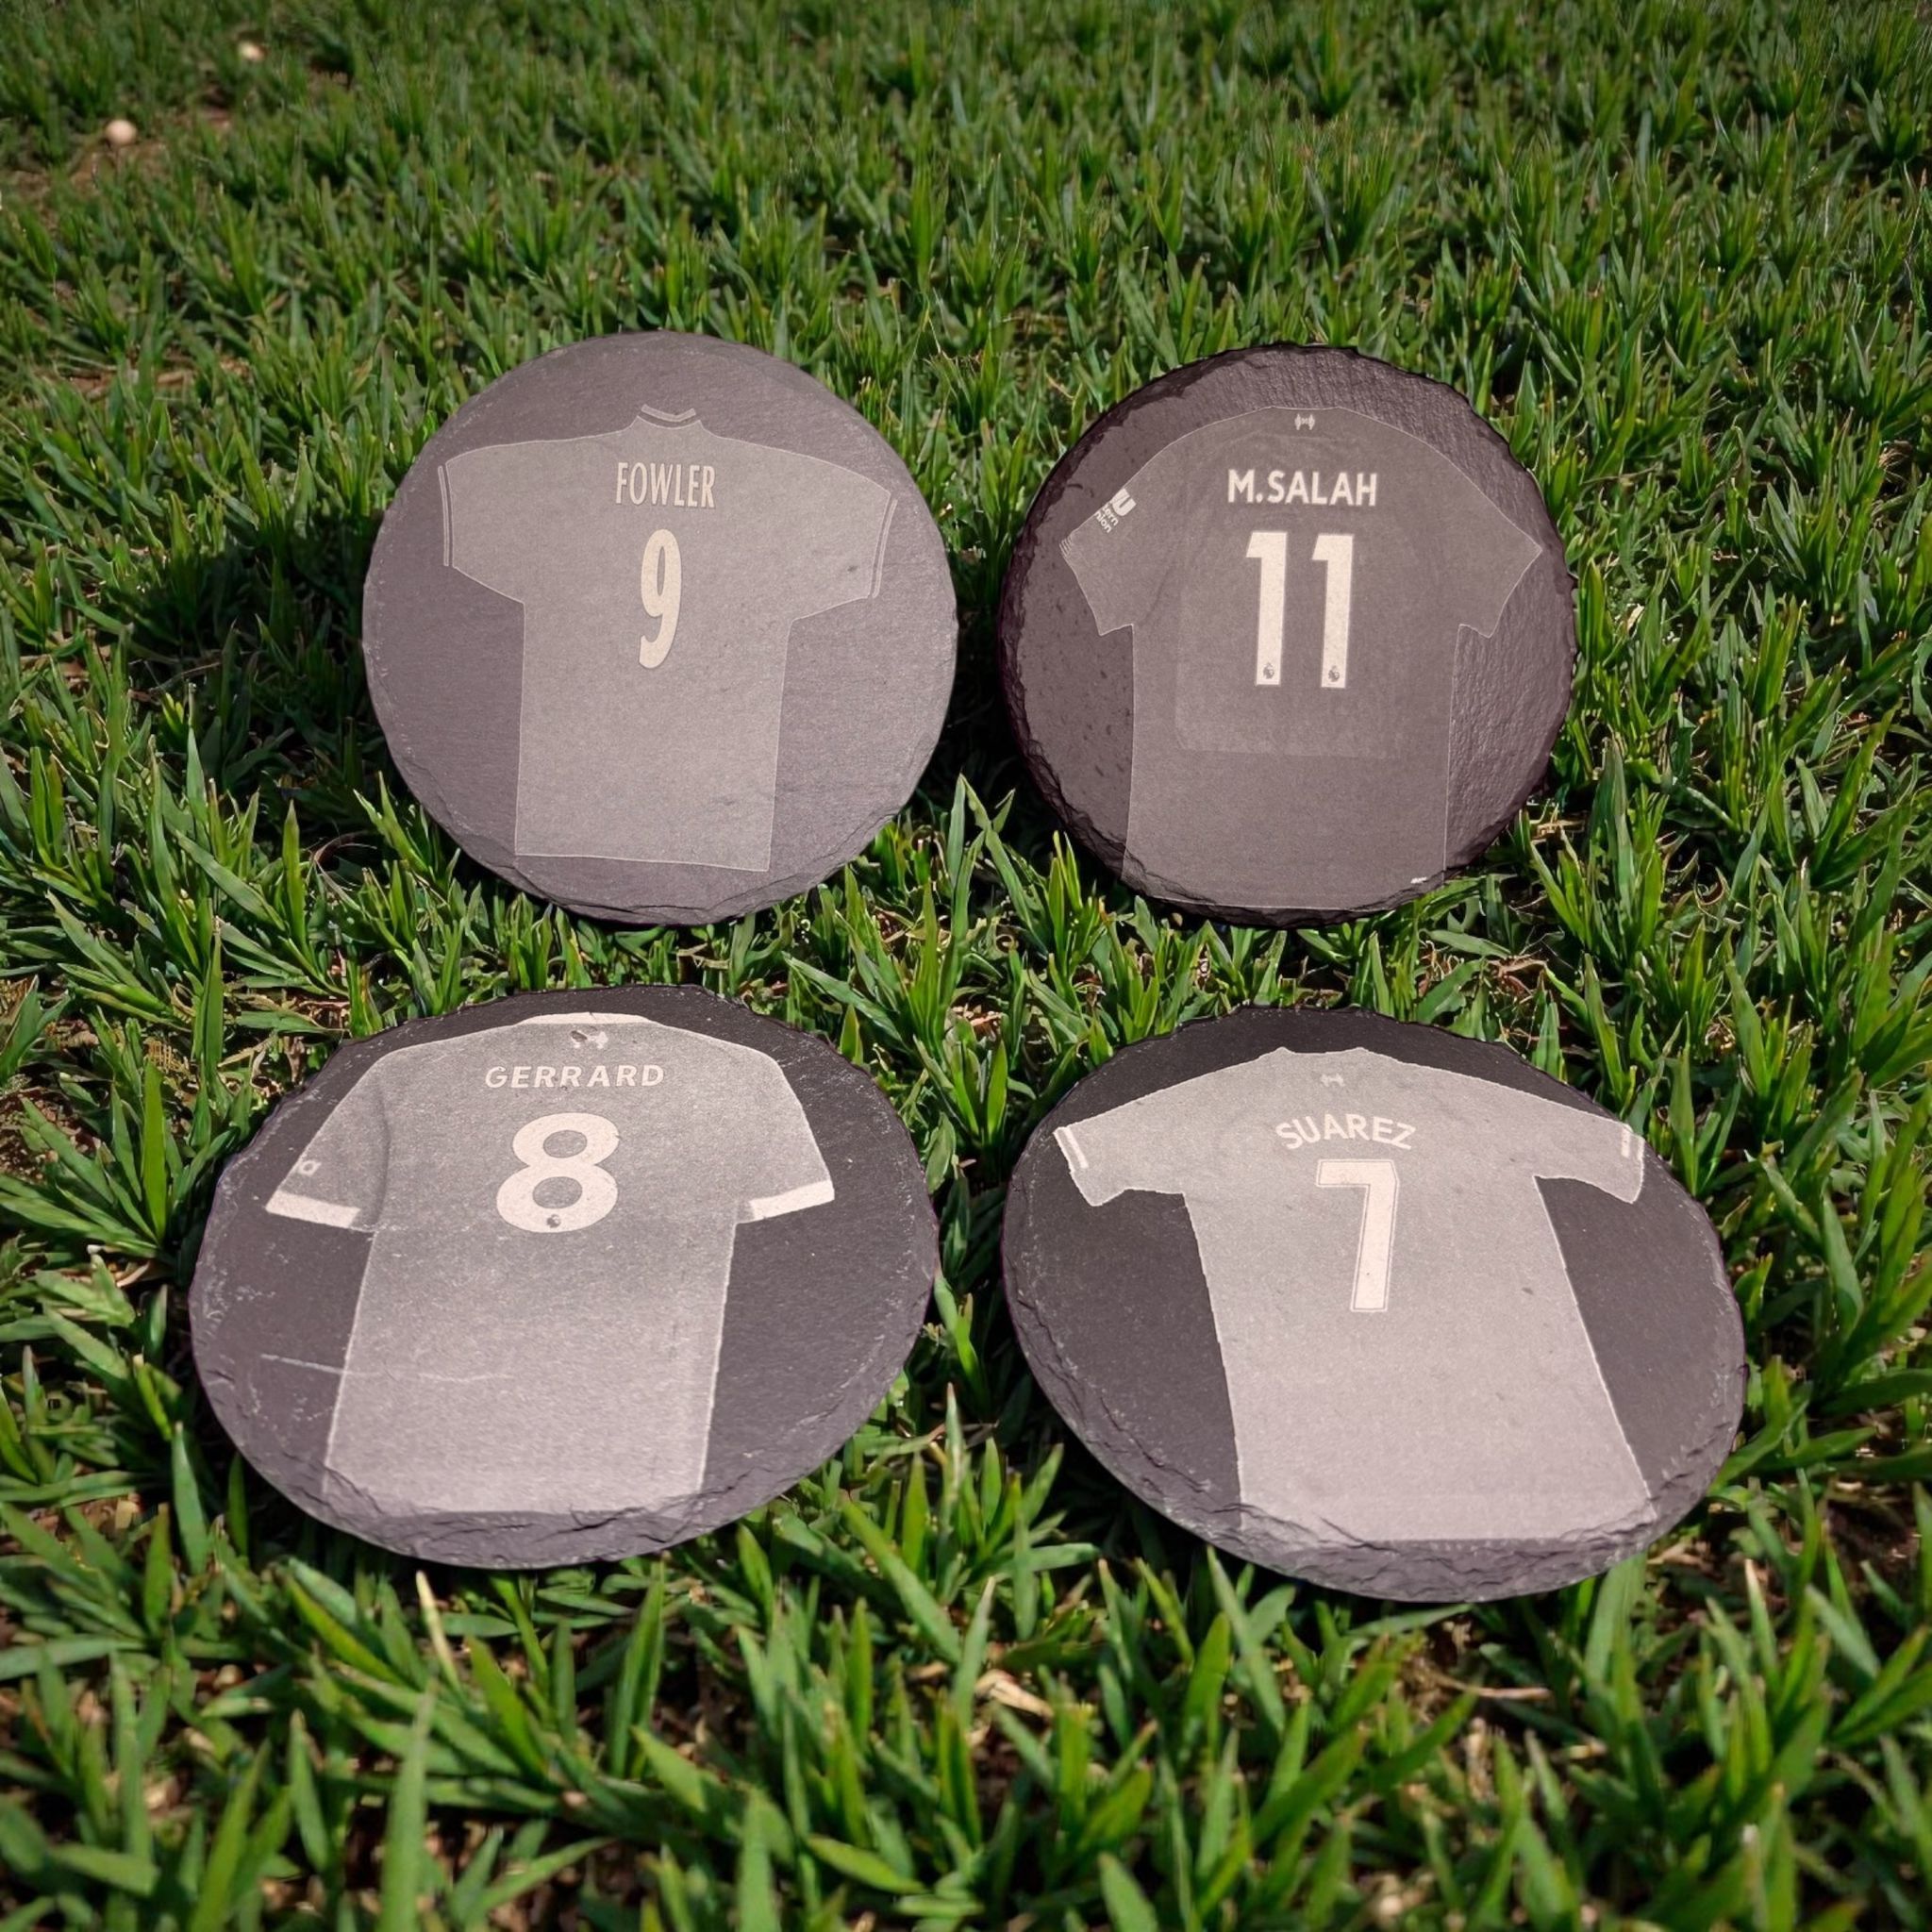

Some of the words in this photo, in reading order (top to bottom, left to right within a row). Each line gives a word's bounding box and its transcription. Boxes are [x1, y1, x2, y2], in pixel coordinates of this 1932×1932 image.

[615, 462, 715, 508] FOWLER
[1227, 469, 1377, 507] M.SALAH
[639, 528, 681, 669] 9
[1245, 531, 1355, 689] 11
[485, 1065, 664, 1088] GERRARD
[496, 1112, 620, 1233] 8
[1275, 1113, 1416, 1150] SUAREZ
[1316, 1158, 1399, 1312] 7
